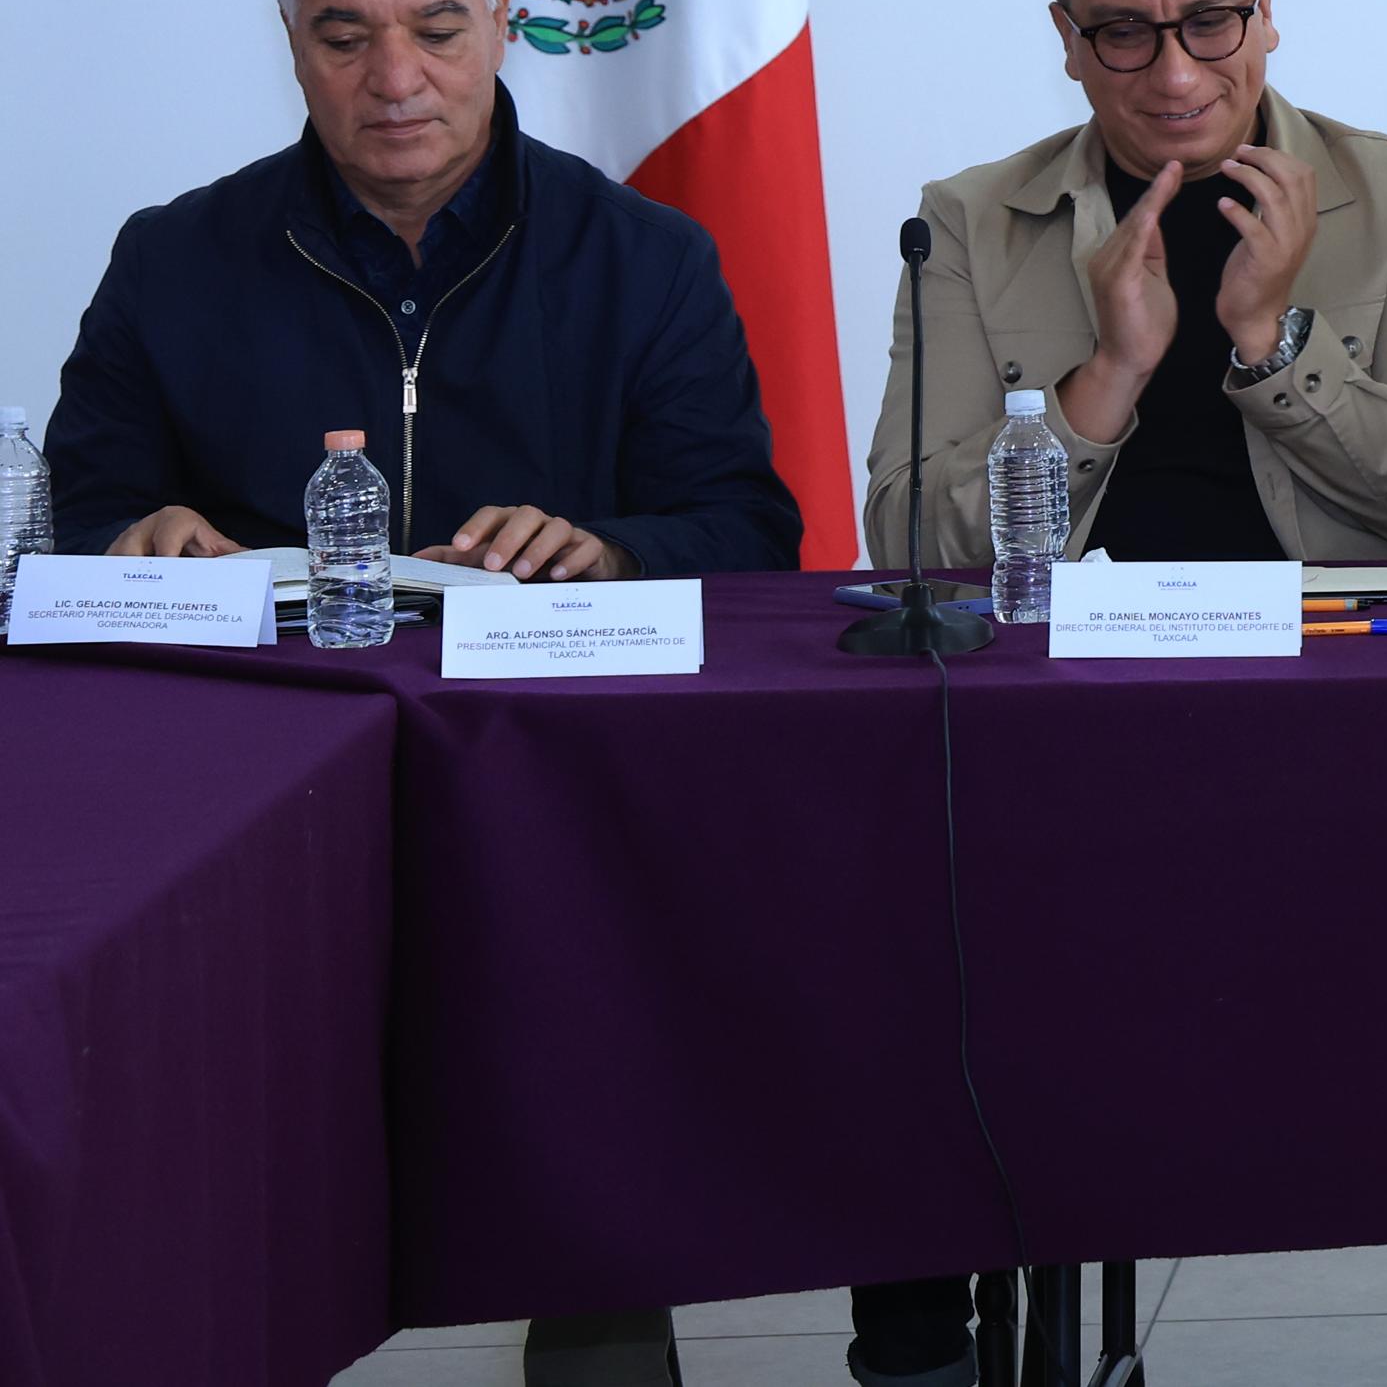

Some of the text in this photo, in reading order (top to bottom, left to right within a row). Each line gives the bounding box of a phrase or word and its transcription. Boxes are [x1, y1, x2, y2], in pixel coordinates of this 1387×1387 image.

[55, 600, 218, 612] LIC. GELACIO MONTIEL FUENTES
[28, 610, 243, 623] SECRETARIO PARTICULAR DEL DESPACHO DE LA
[1090, 612, 1261, 621] DR. DANIEL MONCAYO CERVANTES
[97, 620, 168, 630] GOBERNADORA
[1056, 623, 1102, 632] DIRECTOR
[1105, 623, 1147, 631] GENERAL
[1149, 623, 1167, 631] DEL
[1169, 623, 1216, 631] INSTITUTO
[1218, 623, 1235, 631] DEL
[1237, 623, 1279, 631] DEPORTE
[486, 626, 657, 640] ARQ. ALFONSO SÁNCHEZ GARCÍA
[1153, 634, 1198, 642] TLAXCALA
[457, 642, 516, 651] PRESIDENTE
[518, 641, 567, 650] MUNICIPAL
[589, 639, 598, 647] H.
[600, 638, 671, 647] AYUNTAMIENTO
[548, 650, 595, 659] TLAXCALA
